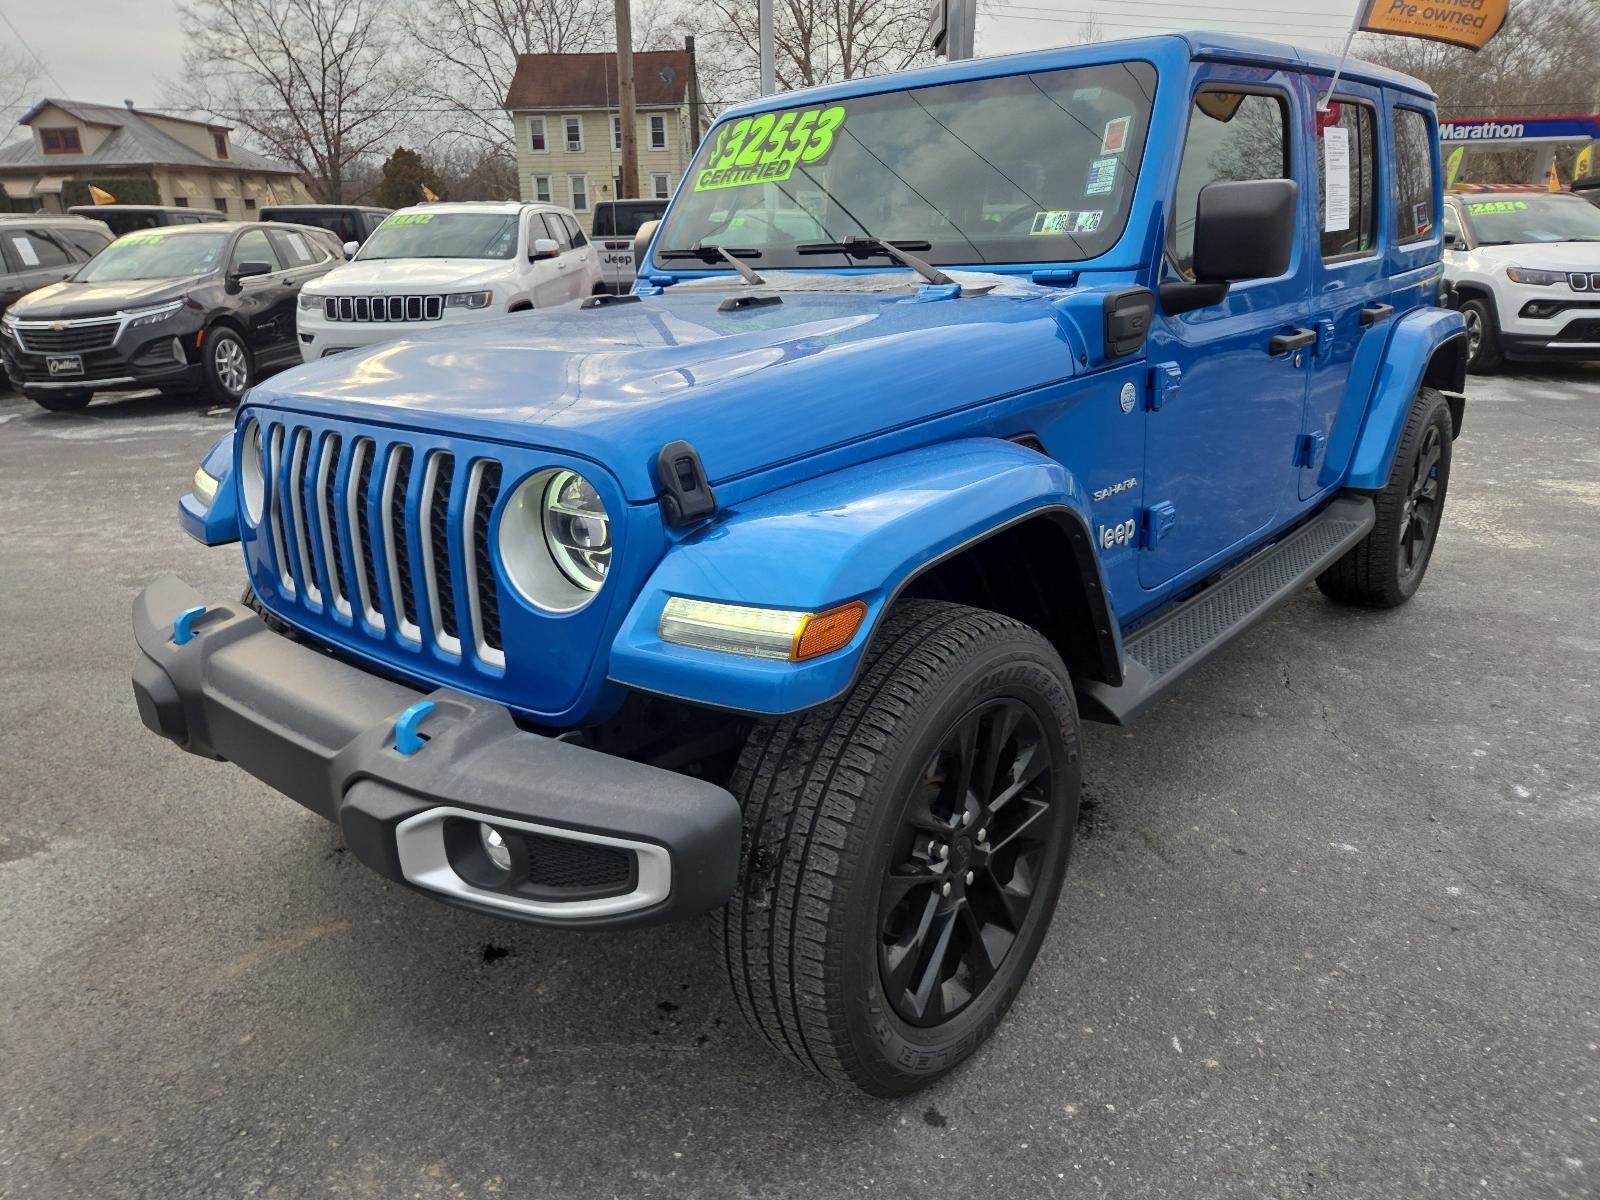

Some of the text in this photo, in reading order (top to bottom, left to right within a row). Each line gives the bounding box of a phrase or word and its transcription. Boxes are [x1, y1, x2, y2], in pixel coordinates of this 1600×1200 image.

[709, 107, 845, 169] $32553
[1439, 122, 1524, 140] Marathon
[700, 160, 790, 186] CERTIFIED
[604, 253, 632, 265] Jeep
[1094, 477, 1138, 502] SAHARA
